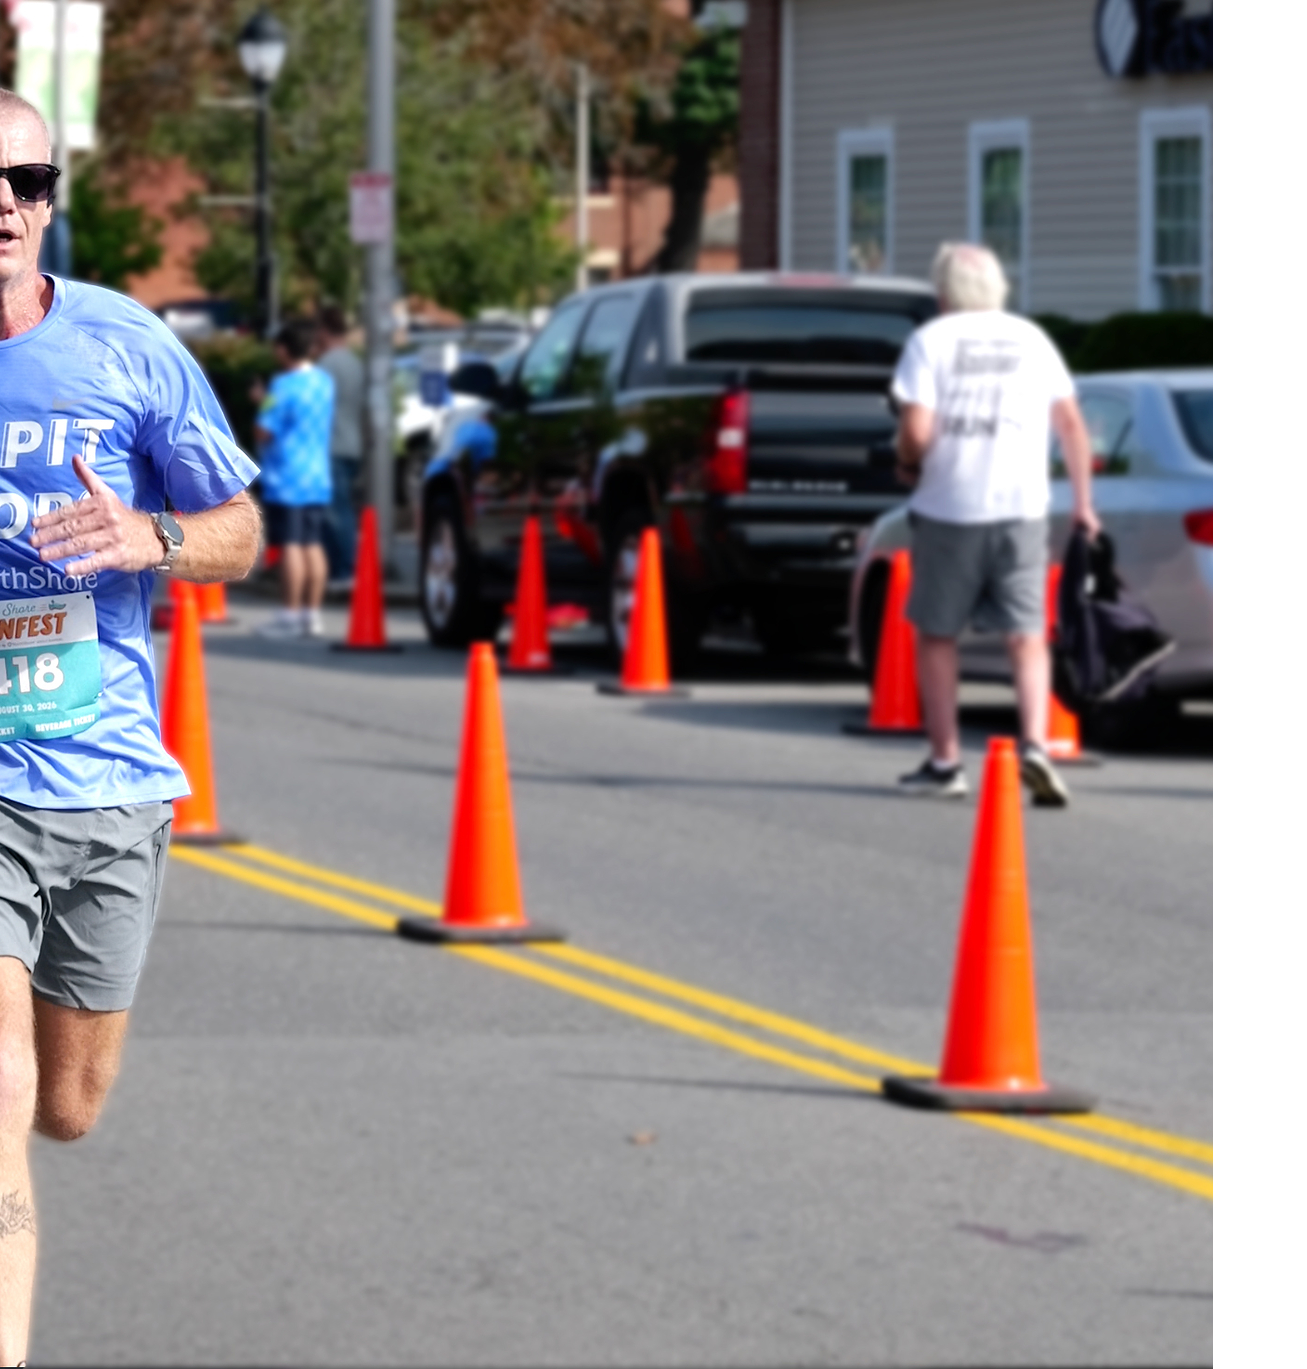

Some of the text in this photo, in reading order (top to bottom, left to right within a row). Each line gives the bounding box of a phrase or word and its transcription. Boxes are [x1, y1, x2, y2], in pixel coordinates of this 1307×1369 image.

[0, 419, 115, 469] PIT
[2, 602, 36, 617] Shore
[35, 714, 95, 732] BEVERAGE TICKET
